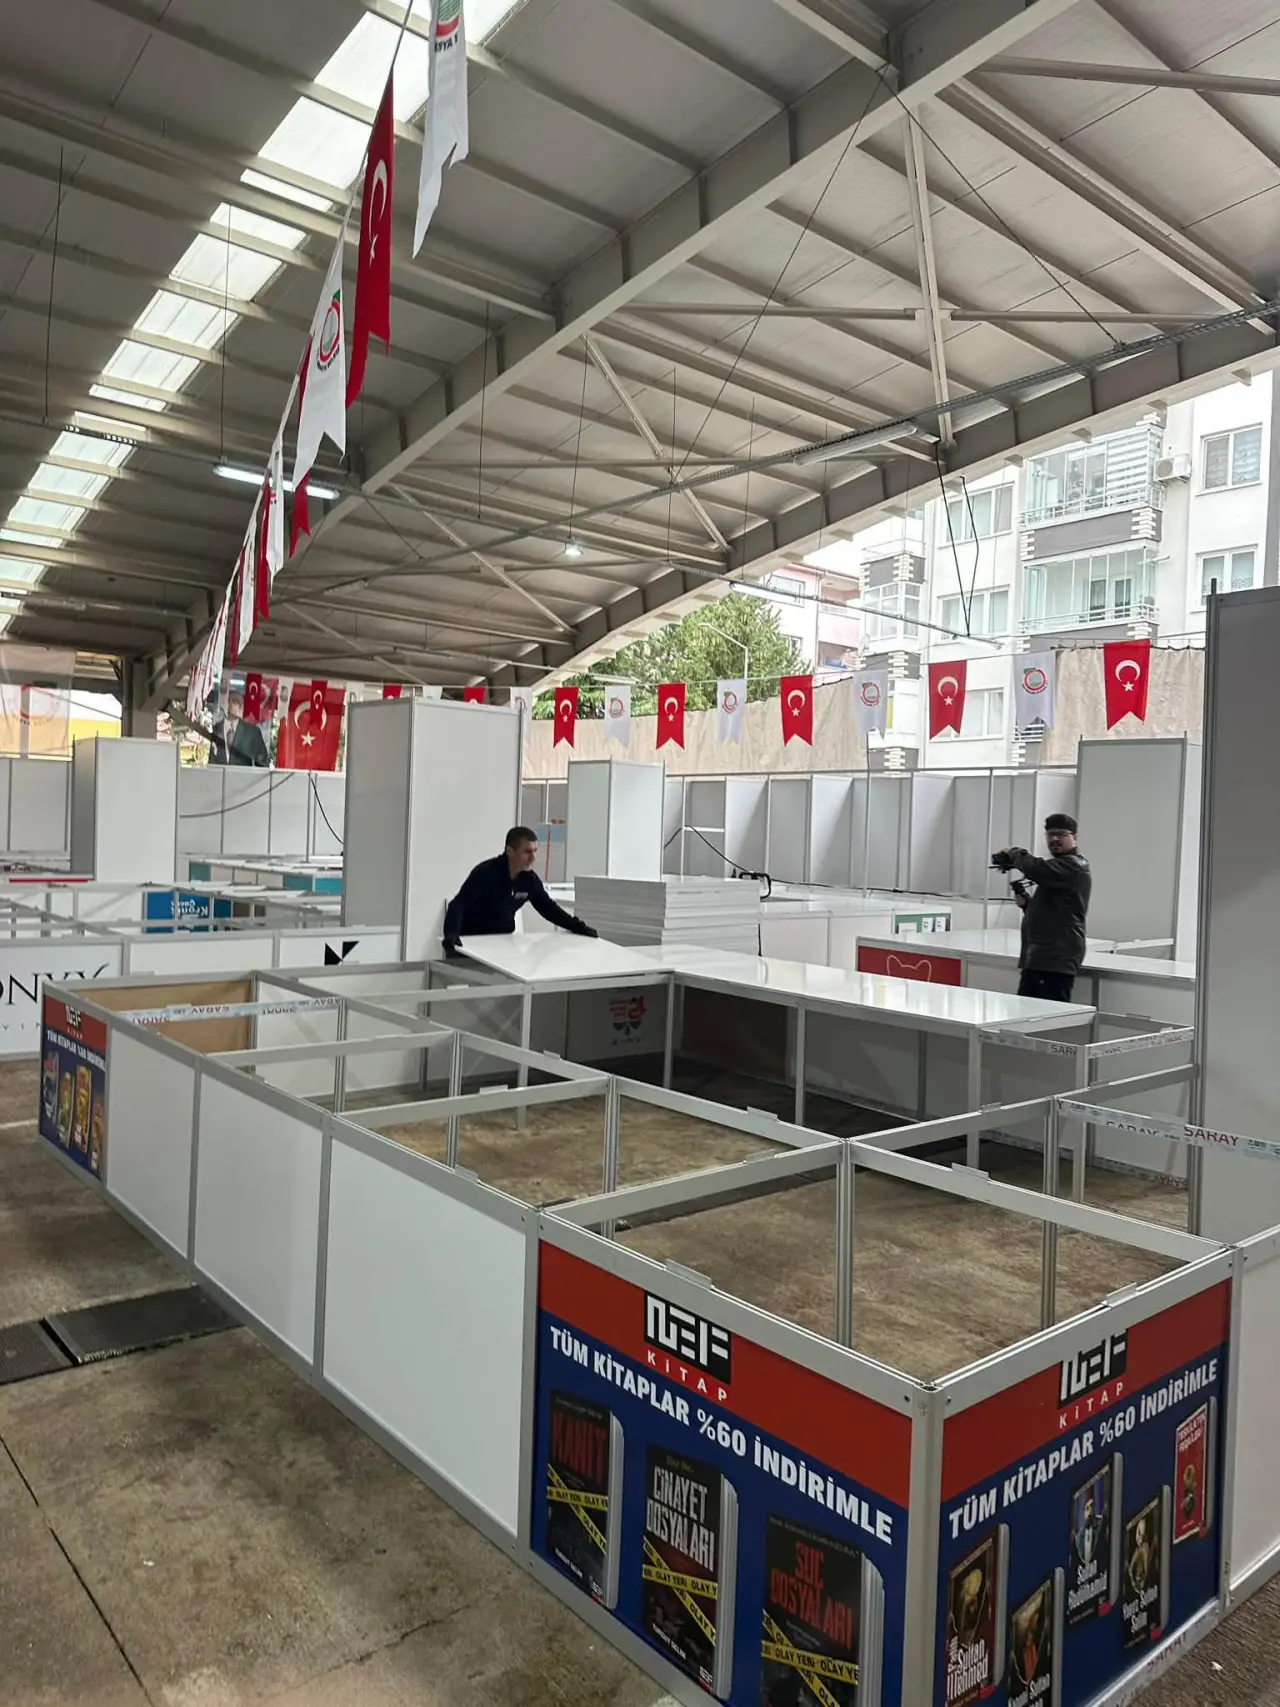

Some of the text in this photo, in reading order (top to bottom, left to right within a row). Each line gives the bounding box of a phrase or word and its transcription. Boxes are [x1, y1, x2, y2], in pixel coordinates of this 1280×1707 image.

[647, 1294, 729, 1367] NEF
[647, 1349, 728, 1401] KİTAP
[1059, 1382, 1124, 1429] KİTAP
[550, 1325, 588, 1368] TÜM
[594, 1350, 690, 1427] KİTAPLAR
[697, 1408, 747, 1457] %60
[754, 1436, 893, 1546] İNDİRİMLE
[949, 1487, 998, 1540] TÜM
[1002, 1430, 1094, 1508] KİTAPLAR
[1100, 1405, 1136, 1448] %60
[1139, 1357, 1218, 1424] İNDİRİMLE
[654, 1465, 708, 1524] CİNAYET
[646, 1498, 714, 1573] DOSYALARI
[957, 1638, 985, 1671] Sultan
